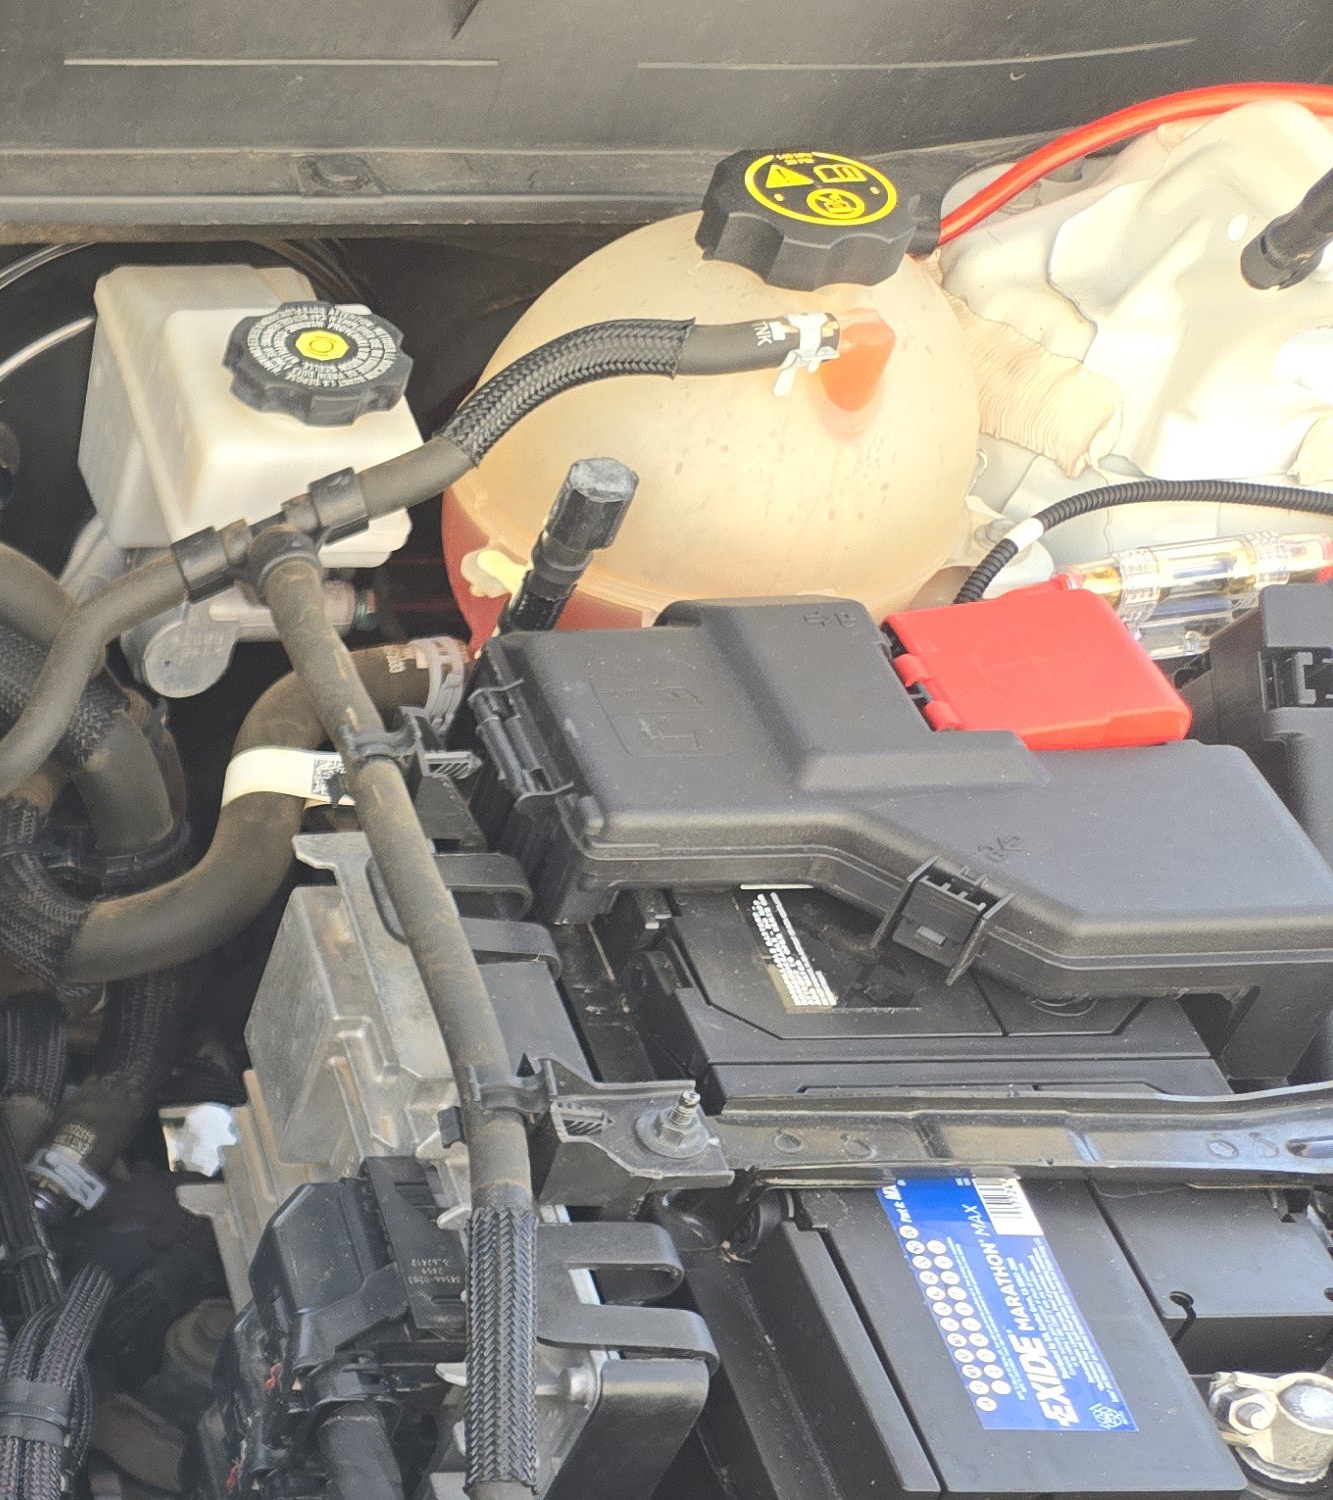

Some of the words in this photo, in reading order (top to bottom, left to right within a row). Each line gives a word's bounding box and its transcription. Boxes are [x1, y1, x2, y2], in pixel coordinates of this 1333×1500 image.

[961, 1203, 991, 1237] MAX
[979, 1242, 1035, 1331] MARATHON
[1007, 1333, 1079, 1427] EXIDE
